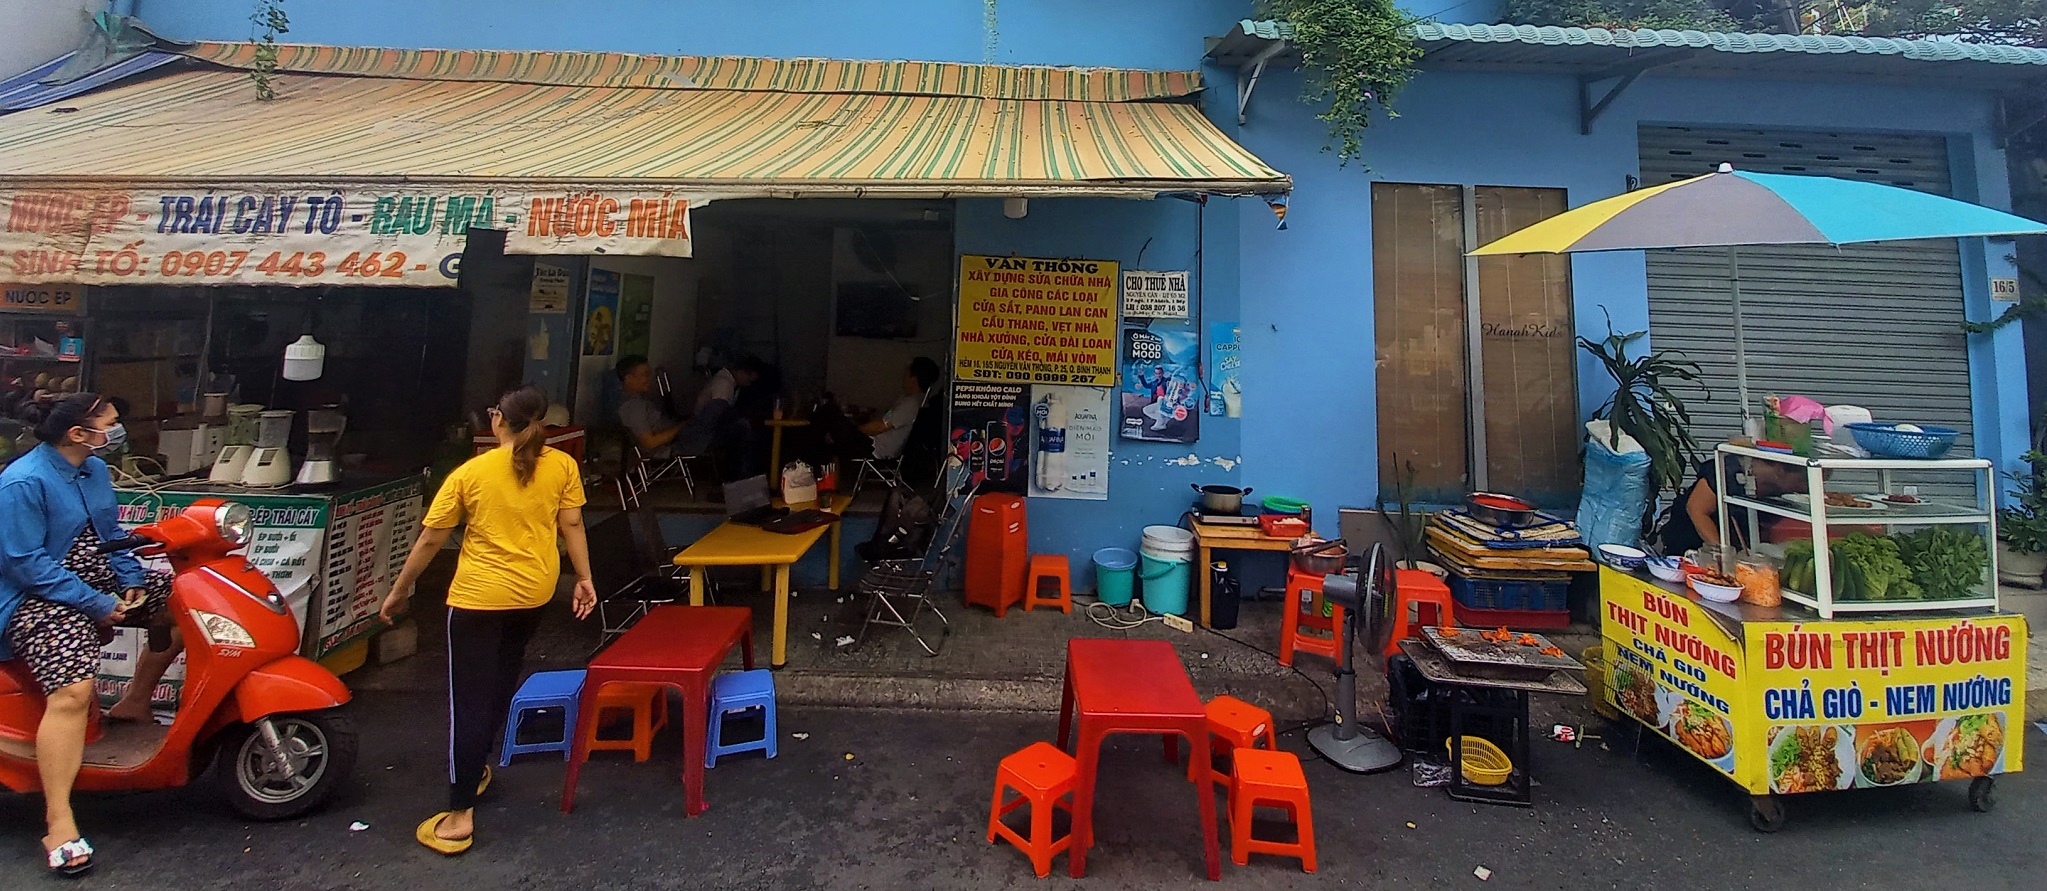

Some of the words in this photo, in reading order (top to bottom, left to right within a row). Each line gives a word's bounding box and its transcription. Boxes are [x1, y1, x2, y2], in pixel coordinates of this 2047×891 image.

[157, 188, 228, 234] TRÁI
[370, 196, 438, 236] RAU
[441, 189, 494, 235] MÁ
[527, 190, 620, 238] NƯỚC
[625, 191, 690, 240] MÍA
[96, 240, 151, 277] TỐ:
[160, 251, 249, 277] 0907
[255, 251, 326, 278] 443
[335, 251, 407, 279] 462
[968, 269, 991, 282] XÂY
[994, 272, 1025, 285] DỰNG
[1028, 272, 1051, 286] SỬA
[1054, 274, 1085, 287] CHỮA
[1126, 276, 1143, 291] CHO
[1145, 273, 1167, 291] THUÊ
[1169, 273, 1186, 291] NHÀ
[990, 287, 1009, 298] GIA
[1012, 287, 1043, 300] CÔNG
[1047, 289, 1069, 302] CÁC
[1073, 291, 1098, 305] LOẠI
[973, 299, 996, 313] CỬA
[1025, 304, 1056, 316] PANO
[1060, 306, 1082, 317] LAN
[1085, 307, 1108, 318] CAN
[1008, 319, 1048, 332] THANG,
[1052, 321, 1072, 334] VẸT
[1075, 321, 1099, 333] NHÀ
[961, 331, 985, 343] NHÀ
[988, 331, 1030, 347] XƯỞNG,
[1034, 333, 1057, 347] CỬA
[1060, 336, 1079, 348] ĐÀI
[1082, 338, 1112, 349] LOAN
[1133, 341, 1162, 351] GOOD
[1046, 350, 1068, 363] MÁI
[1072, 351, 1097, 364] VÒM
[1132, 350, 1161, 359] MOOD
[973, 369, 1002, 379] SĐT:
[976, 384, 1002, 393] KHÔNG
[272, 506, 296, 524] TRÁI
[296, 506, 319, 525] CÂY
[1643, 591, 1689, 627] BÚN
[1607, 601, 1648, 635] THỊT
[1655, 622, 1736, 680] NƯỚNG
[1766, 625, 1831, 669] BÚN
[1842, 631, 1905, 676] THỊT
[1916, 621, 2010, 667] NƯỚNG
[217, 648, 242, 658] SYM
[1633, 638, 1667, 664] CHẢ
[1674, 658, 1706, 683] GIÒ
[1617, 647, 1654, 674] NEM
[1660, 669, 1729, 715] NƯỚNG
[1765, 679, 1814, 719] CHẢ
[1823, 681, 1862, 718] GIÒ
[1886, 685, 1936, 716] NEM
[1943, 675, 2011, 711] NƯỚNG
